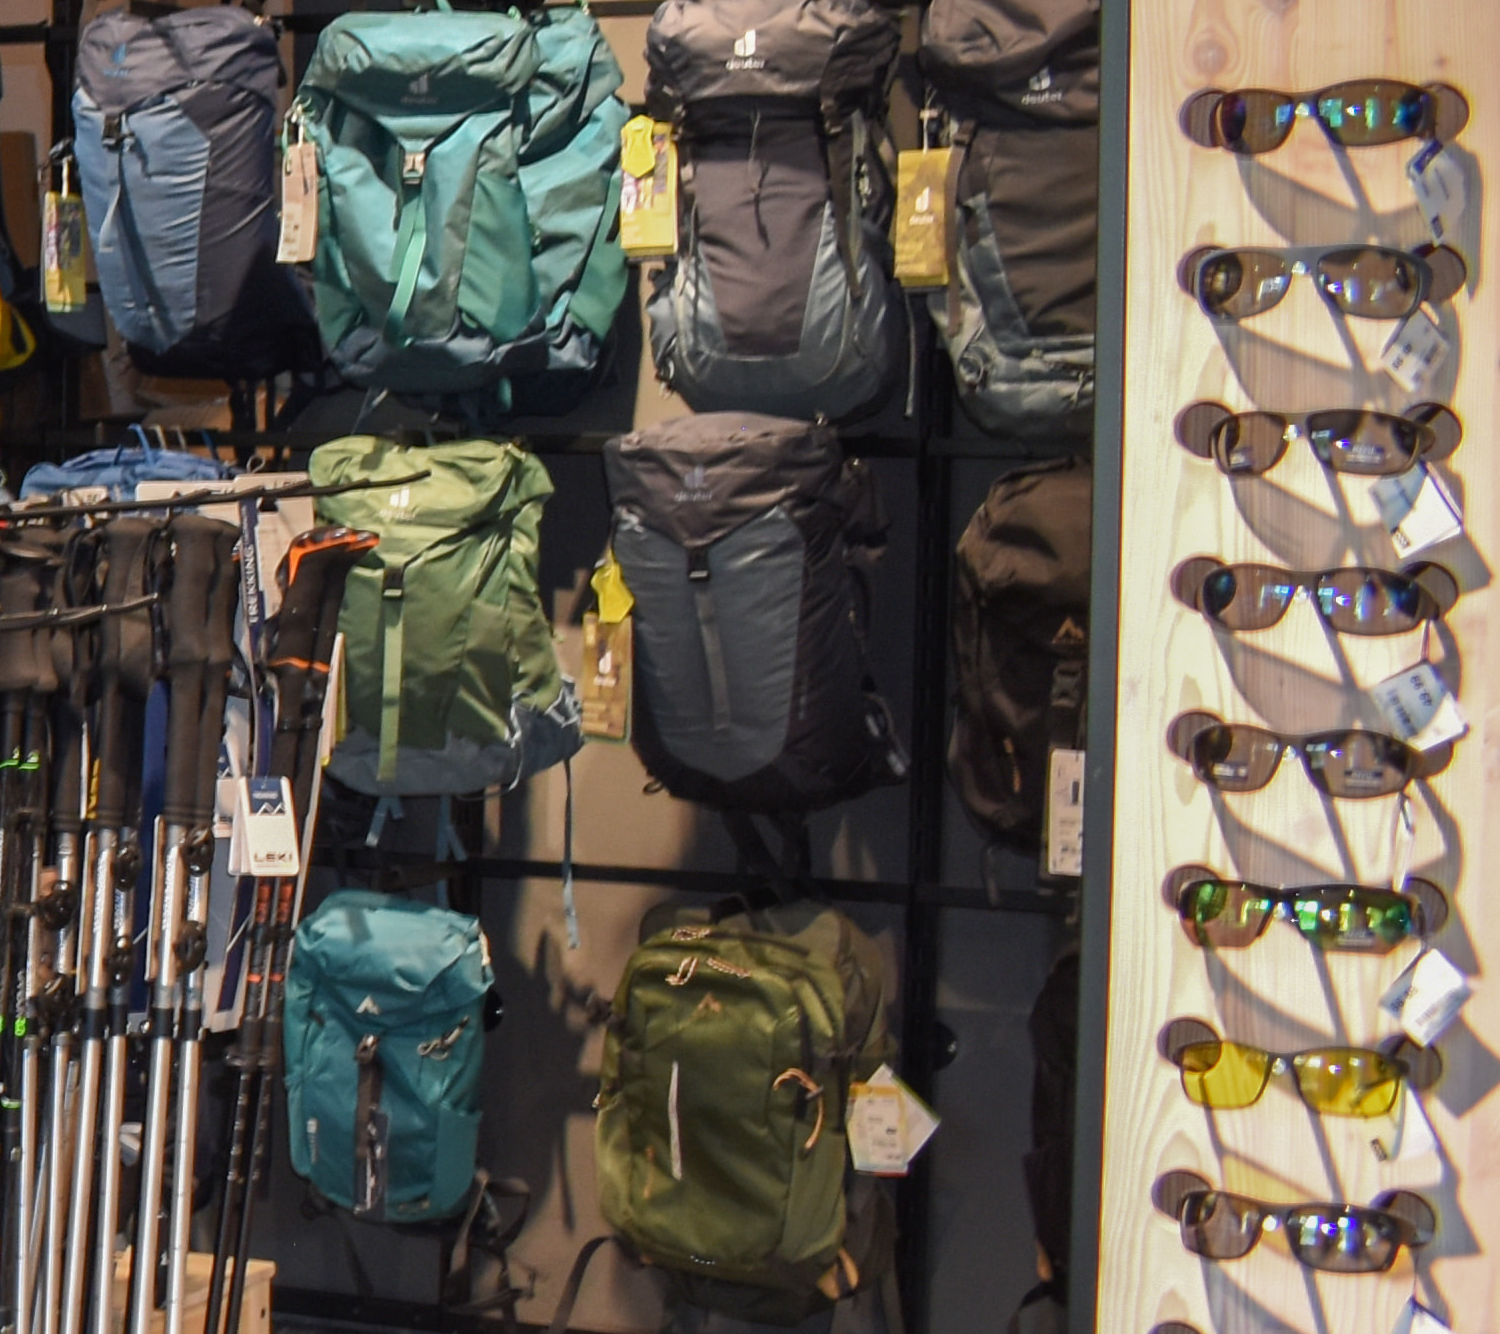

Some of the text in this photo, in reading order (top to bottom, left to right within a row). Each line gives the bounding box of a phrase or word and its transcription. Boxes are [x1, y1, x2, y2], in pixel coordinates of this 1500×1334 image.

[1021, 91, 1063, 106] deuter
[244, 543, 257, 625] TREKKING
[253, 850, 293, 864] LEKI
